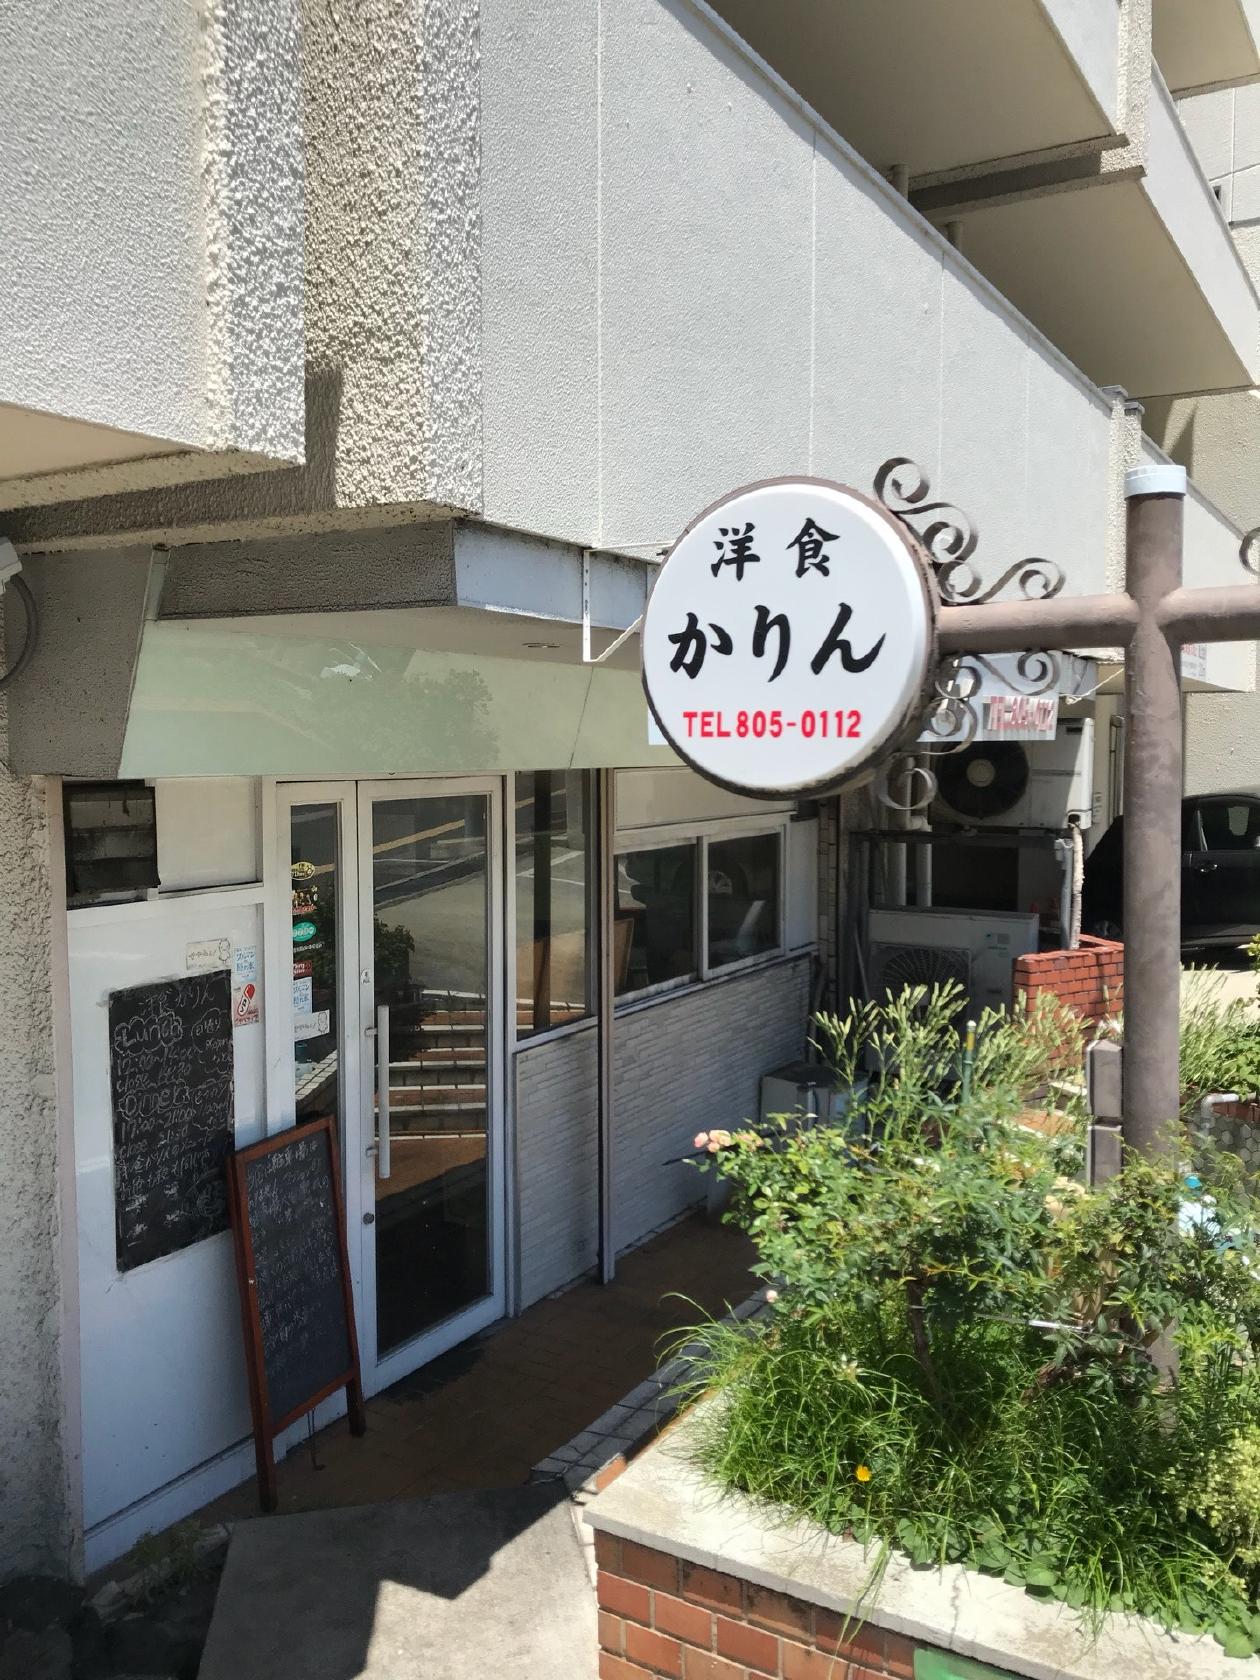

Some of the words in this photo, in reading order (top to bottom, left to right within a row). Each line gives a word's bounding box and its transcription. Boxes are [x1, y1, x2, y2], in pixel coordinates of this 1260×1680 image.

[710, 517, 841, 582] 洋食
[667, 602, 886, 683] かりん
[122, 1013, 182, 1048] Lunch
